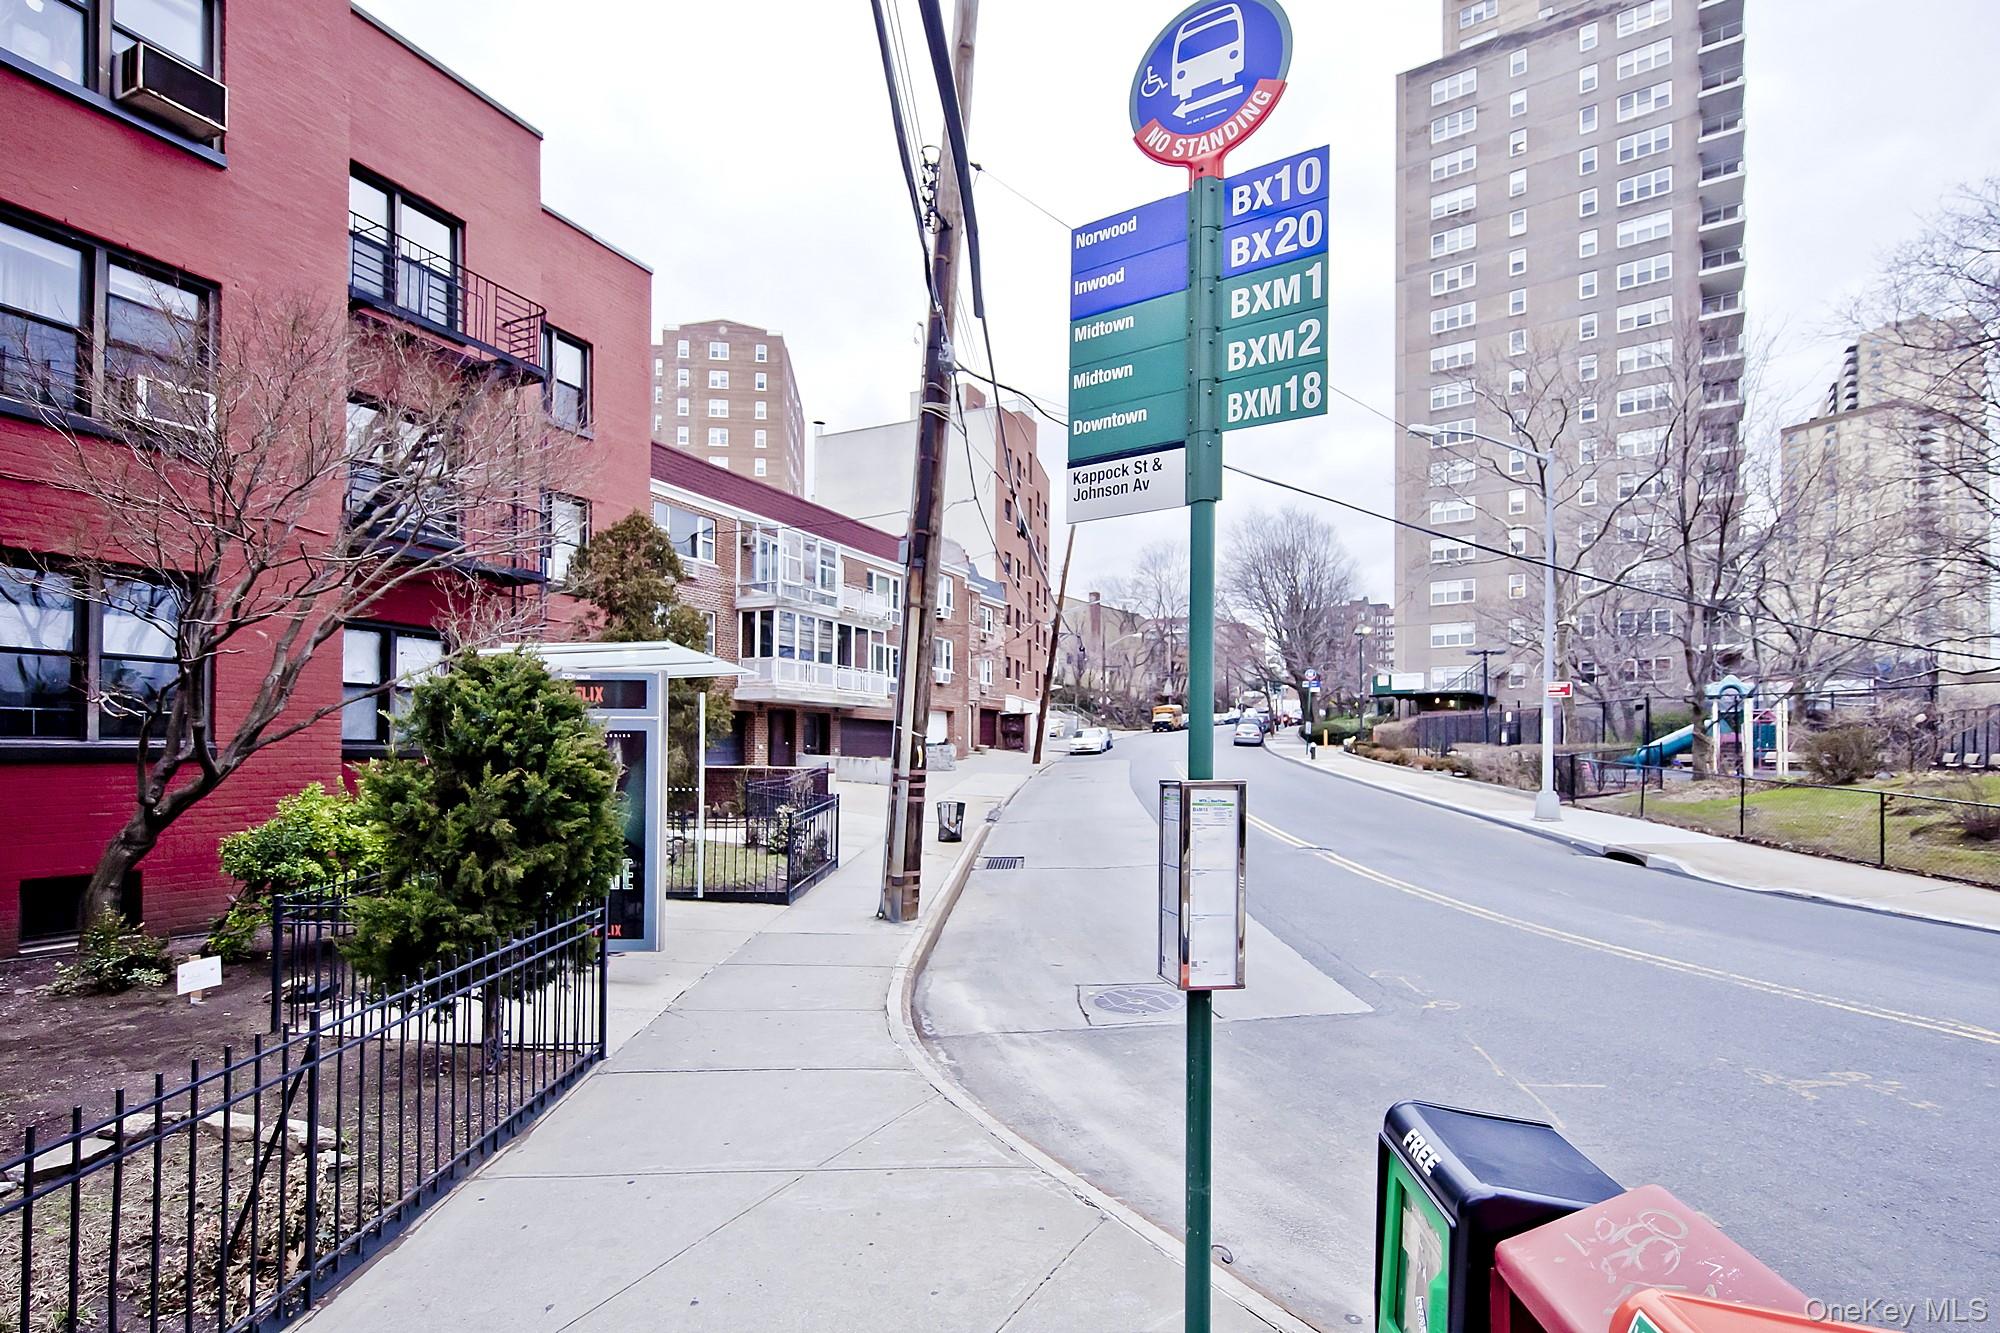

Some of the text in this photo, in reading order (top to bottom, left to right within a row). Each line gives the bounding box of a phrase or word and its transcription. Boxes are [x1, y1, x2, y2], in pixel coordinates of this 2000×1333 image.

[1145, 89, 1272, 158] NO STANDING
[1231, 156, 1322, 217] BX10
[1075, 215, 1137, 250] Norwood
[1230, 209, 1323, 268] BX20
[1074, 266, 1125, 296] Inwood
[1074, 315, 1135, 343] Midtown
[1073, 364, 1133, 390] Midtown
[1073, 408, 1147, 436] Downtown
[1072, 457, 1163, 488] Kappock St &
[1073, 478, 1150, 502] Johnson Av
[1402, 1127, 1443, 1177] FREE
